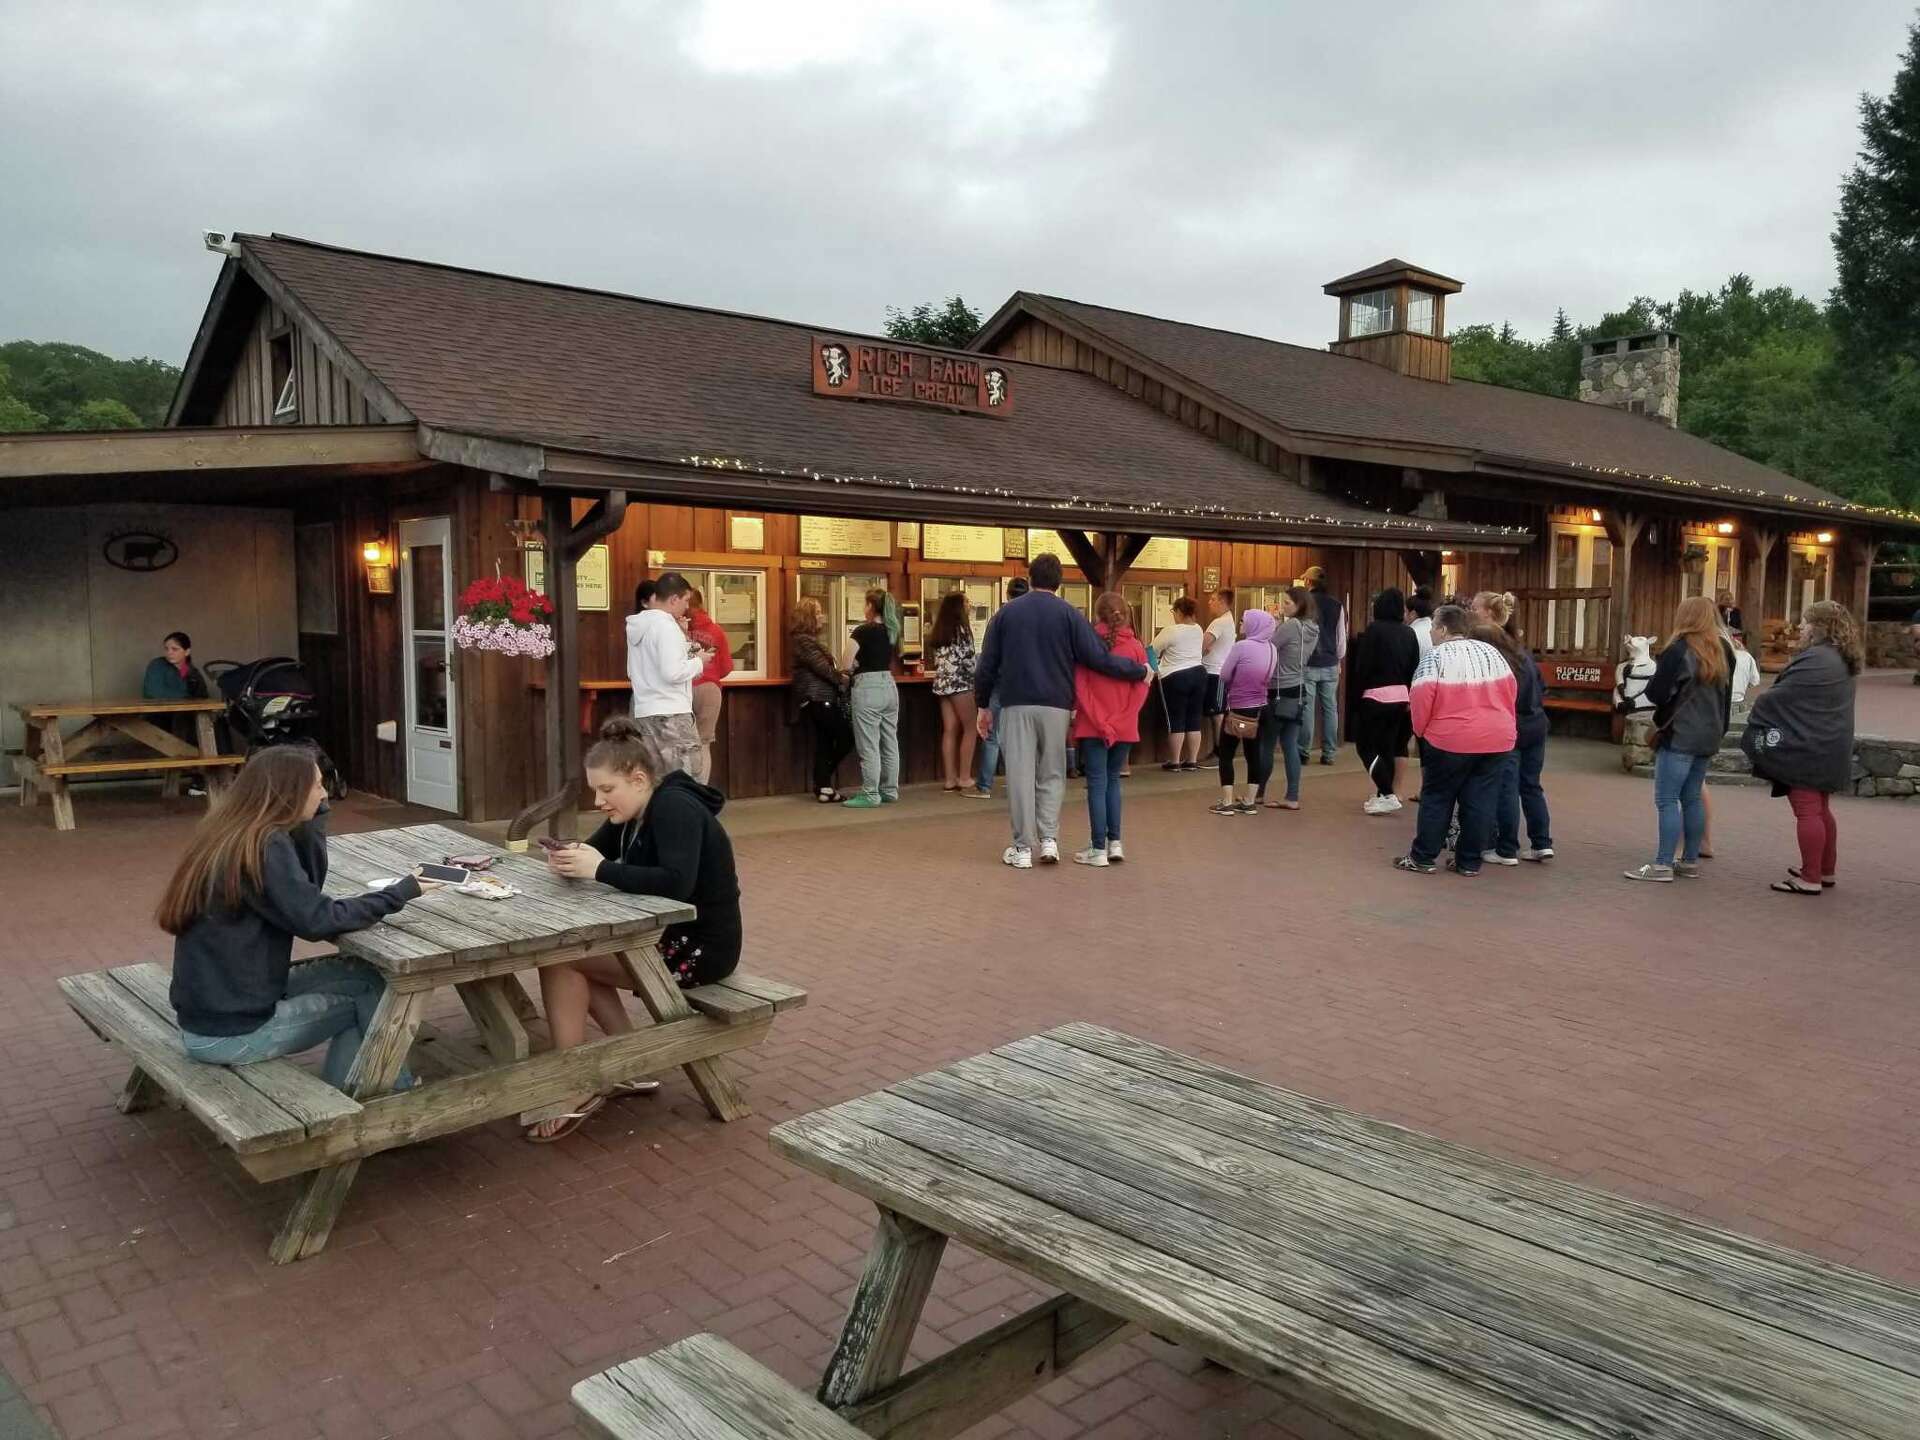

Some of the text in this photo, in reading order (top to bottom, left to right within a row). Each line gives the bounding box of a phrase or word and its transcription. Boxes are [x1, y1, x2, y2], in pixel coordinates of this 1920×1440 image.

[859, 347, 980, 386] RICH FARM
[871, 375, 968, 405] ICE CREAM
